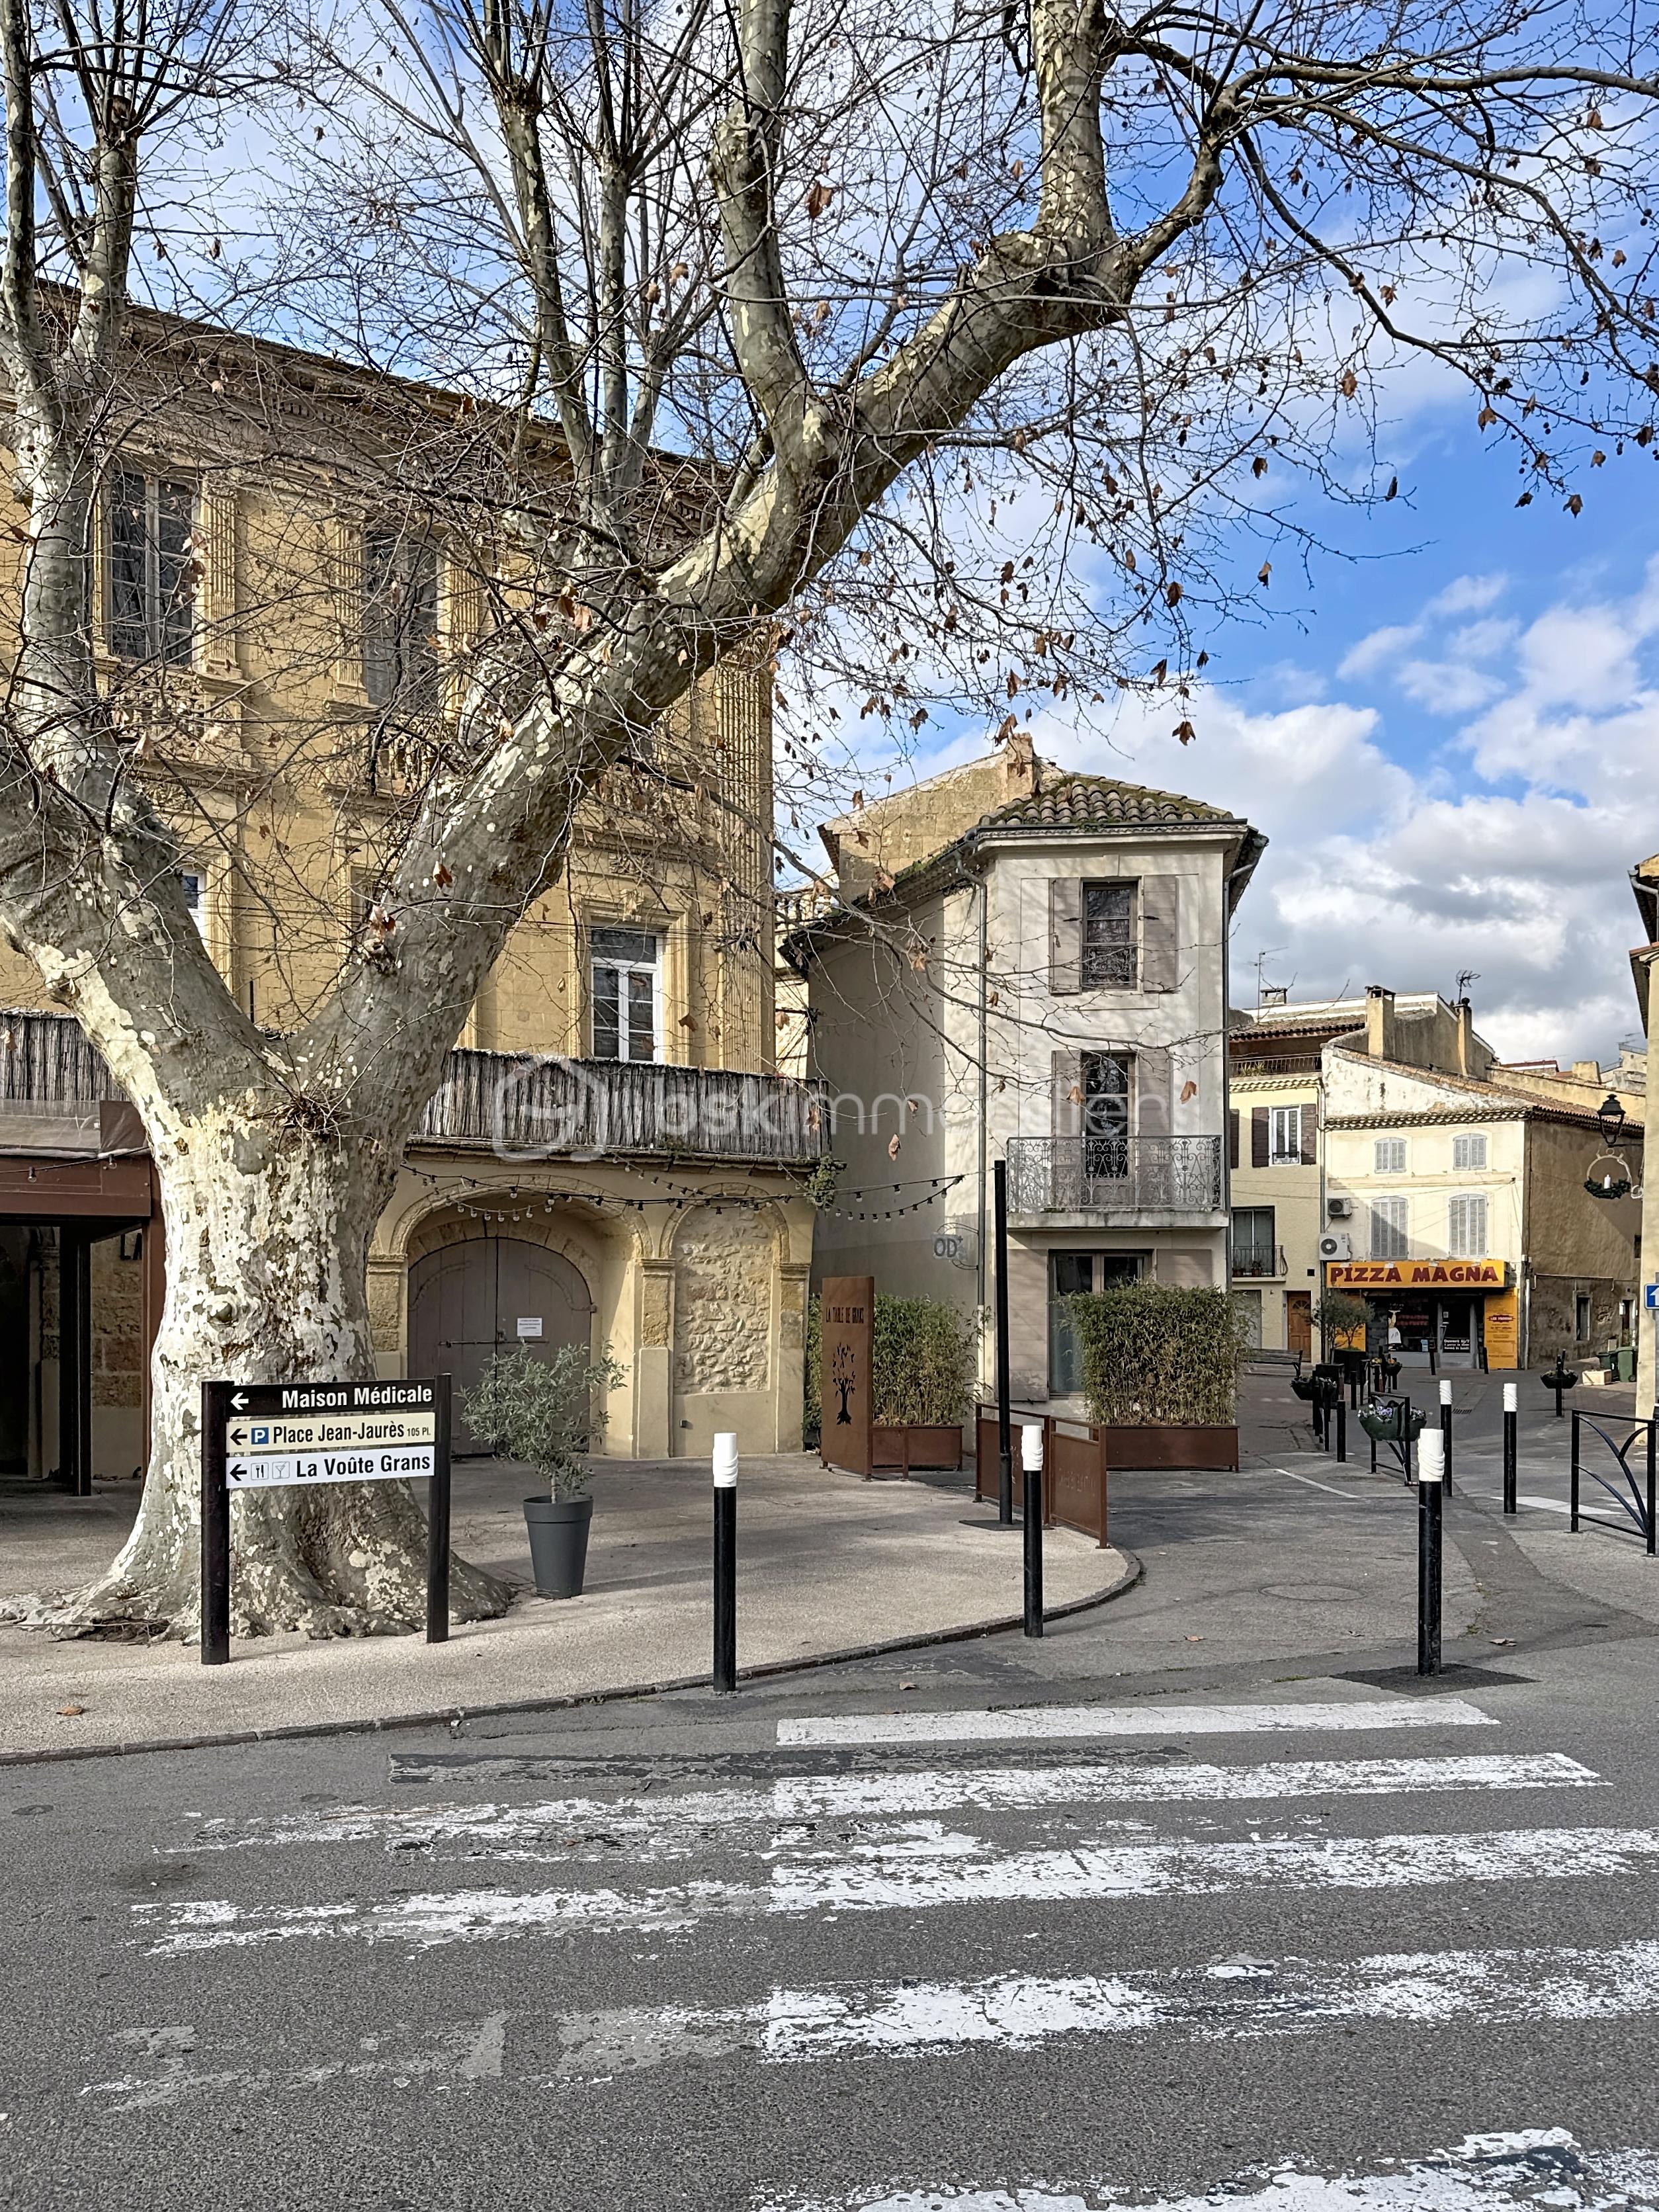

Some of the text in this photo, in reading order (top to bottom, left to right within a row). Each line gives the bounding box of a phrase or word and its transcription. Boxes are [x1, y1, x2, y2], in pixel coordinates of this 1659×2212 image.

[1330, 1266, 1499, 1283] PIZZA MAGNA
[282, 1384, 433, 1408] Maison Médicale
[273, 1425, 313, 1444] Place
[318, 1421, 404, 1442] Jean-Jaurès
[407, 1427, 420, 1437] 105
[296, 1454, 431, 1478] La Voûte Grans
